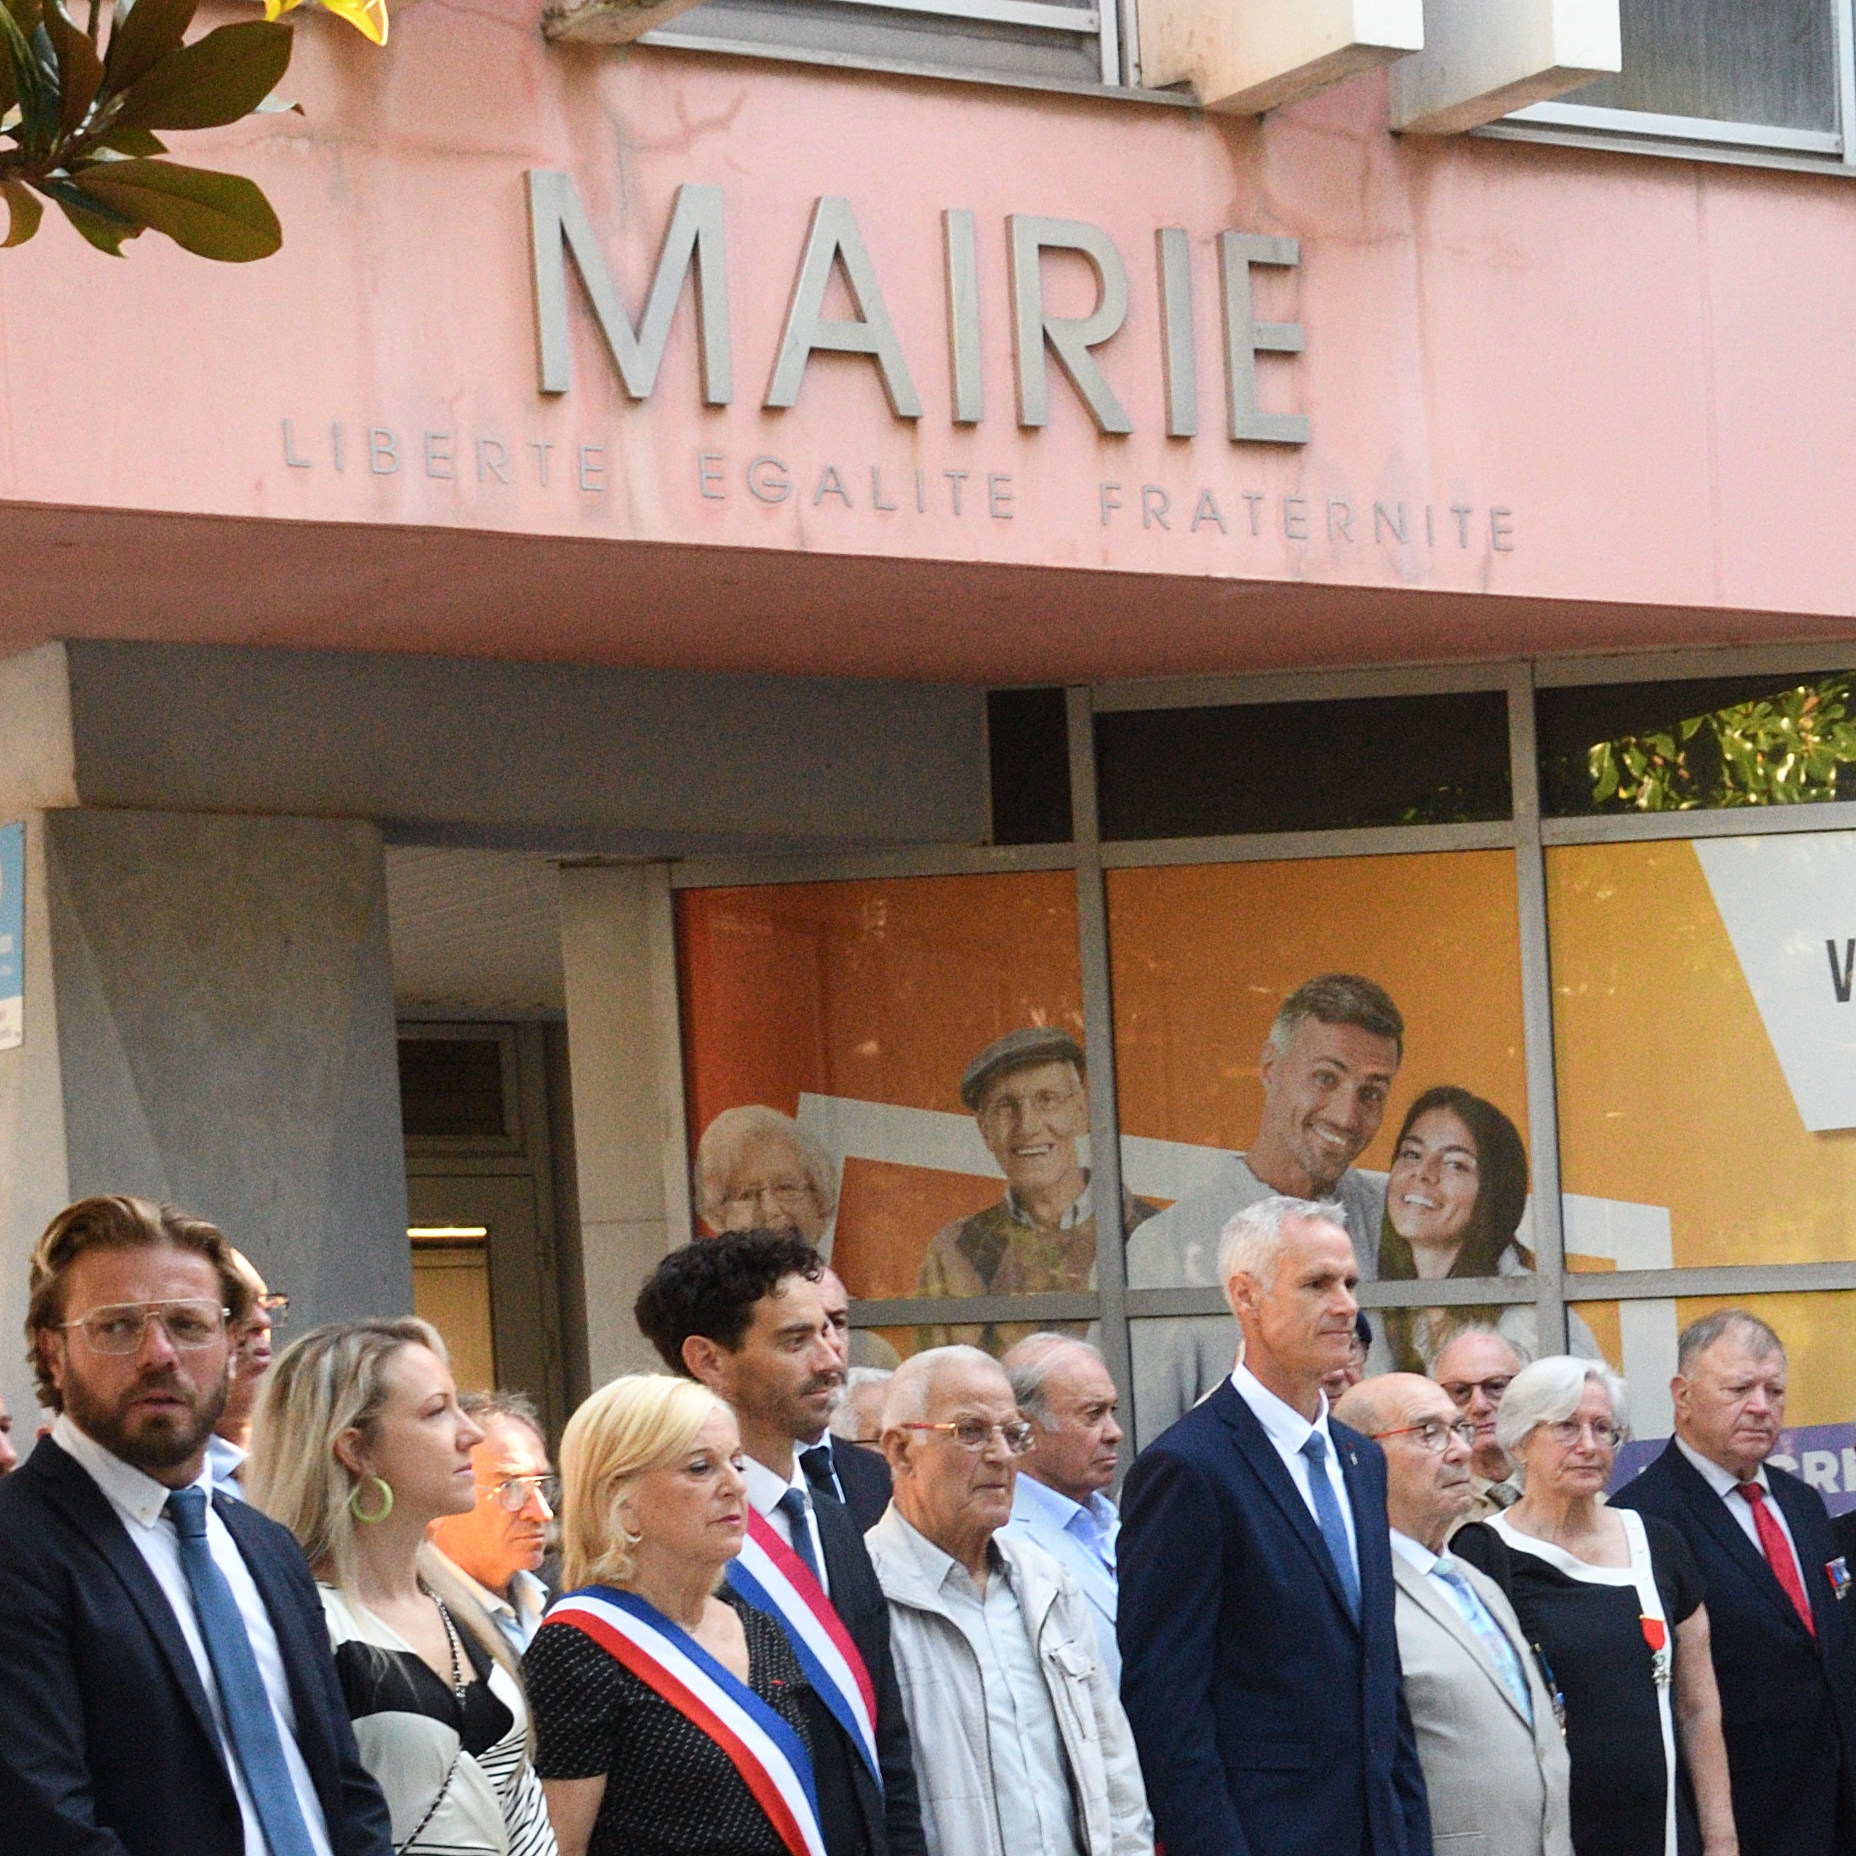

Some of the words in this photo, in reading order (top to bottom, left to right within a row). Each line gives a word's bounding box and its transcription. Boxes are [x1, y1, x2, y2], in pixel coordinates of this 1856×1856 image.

[523, 168, 1310, 446] MAIRIE
[282, 418, 607, 493] LIBERTE
[698, 452, 1016, 520] EGALITE
[1100, 481, 1518, 553] FRATERNITE
